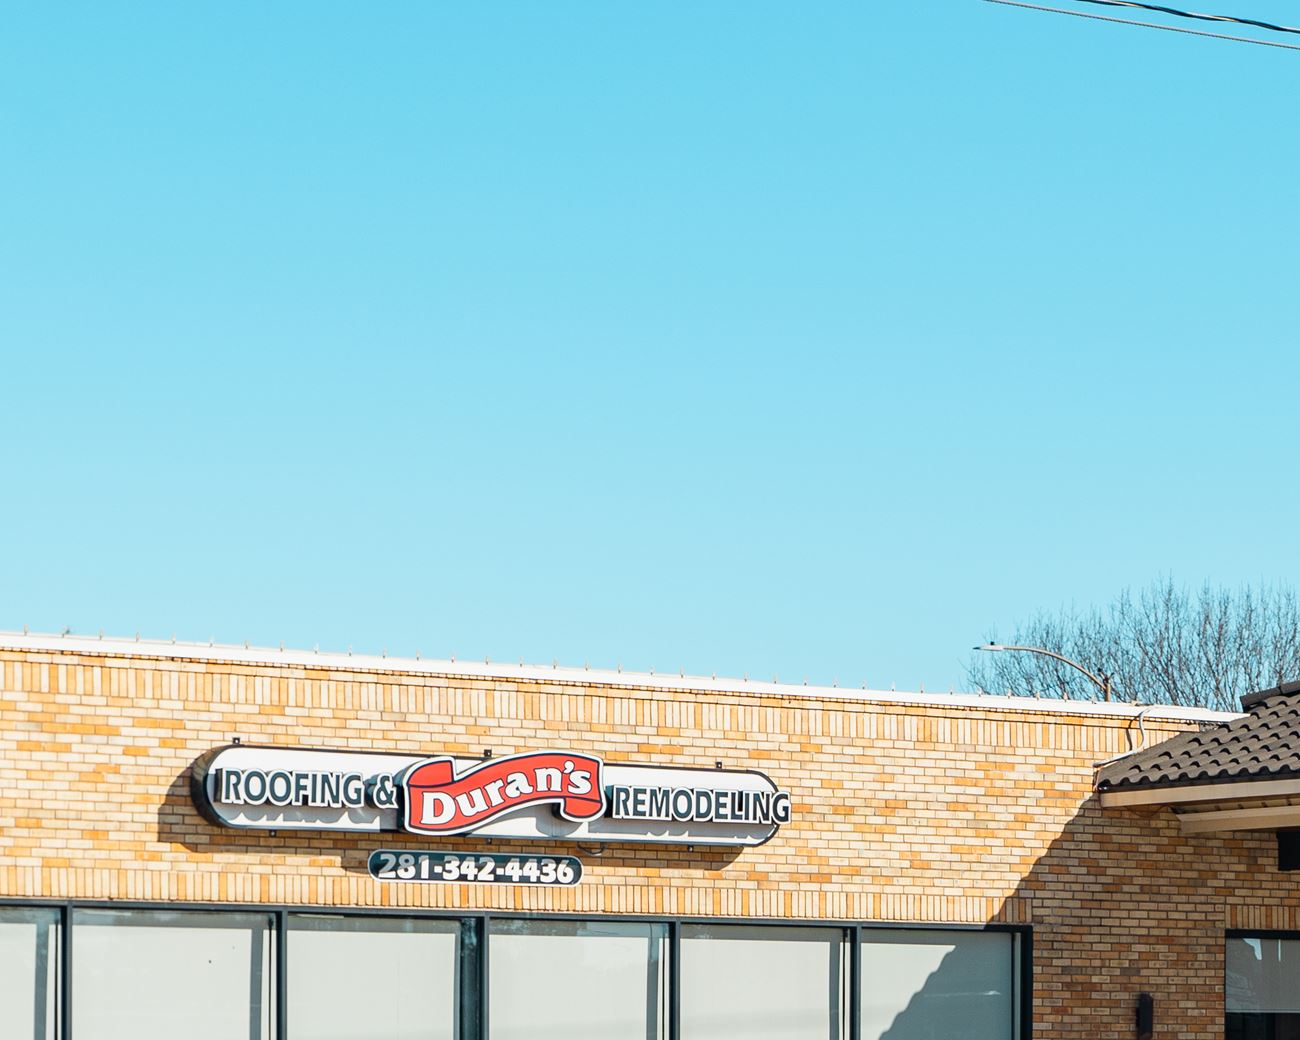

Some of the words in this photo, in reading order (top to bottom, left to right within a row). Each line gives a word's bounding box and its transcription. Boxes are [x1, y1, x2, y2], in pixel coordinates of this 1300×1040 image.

[223, 769, 364, 807] ROOFING
[374, 774, 396, 807] &
[420, 760, 592, 825] Duran's
[613, 786, 791, 825] REMODELING
[378, 853, 575, 884] 281-342-4436
